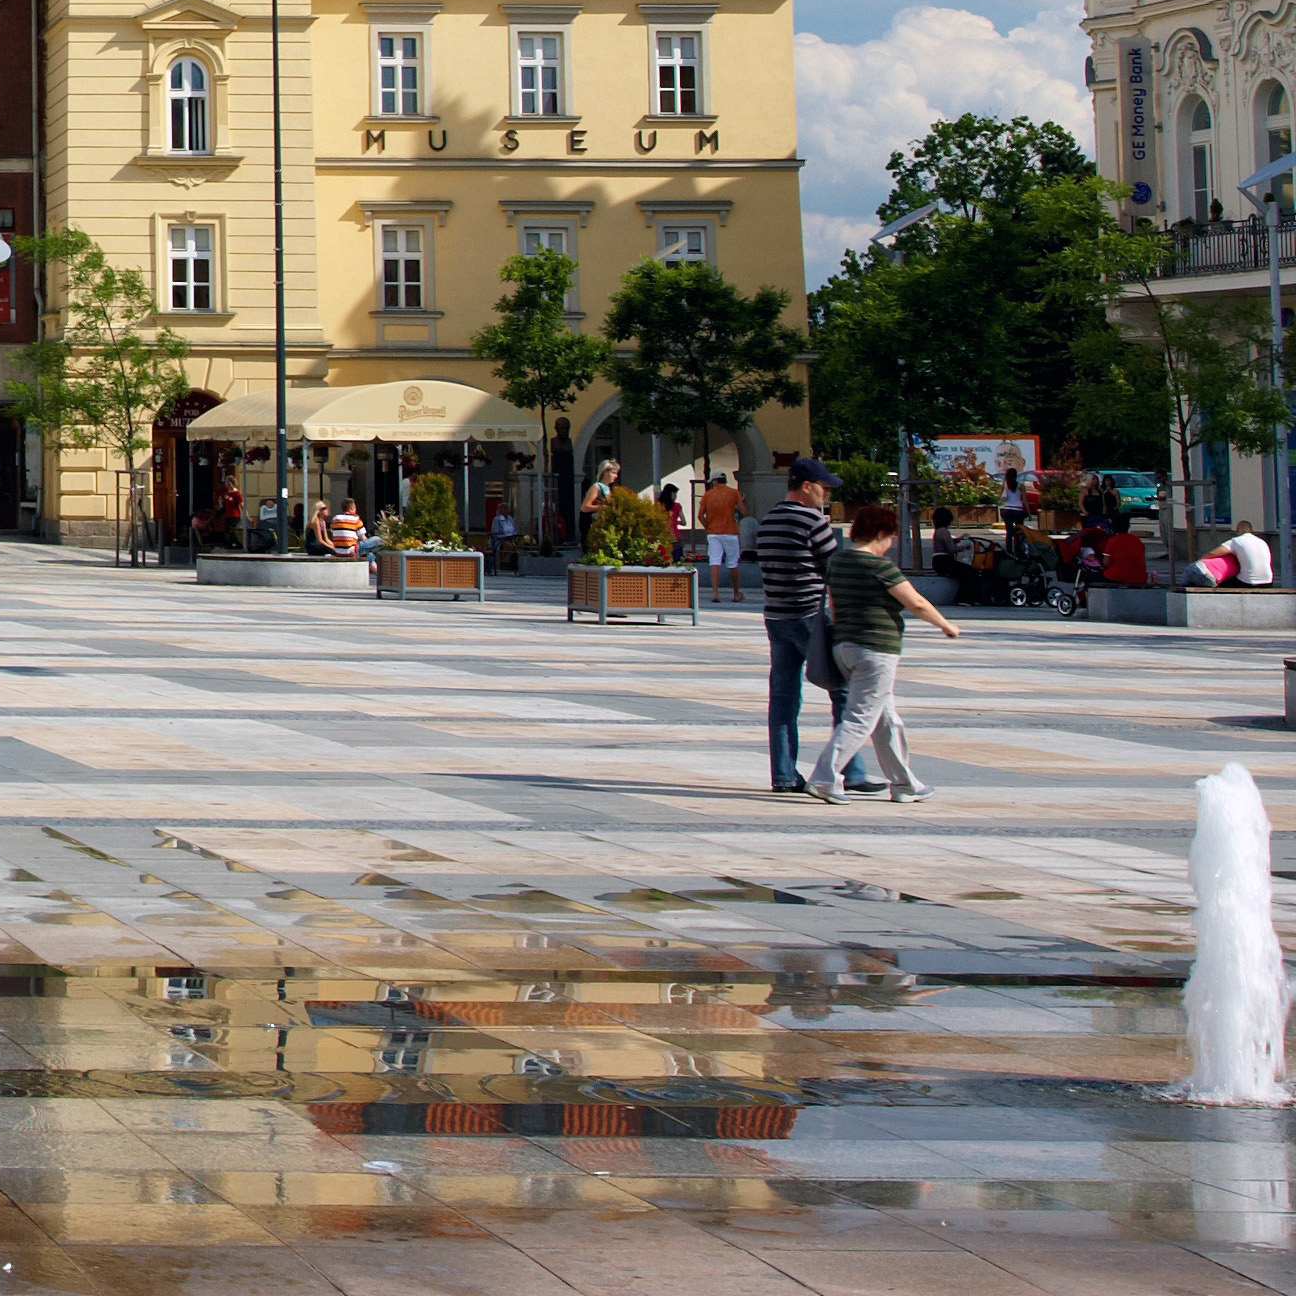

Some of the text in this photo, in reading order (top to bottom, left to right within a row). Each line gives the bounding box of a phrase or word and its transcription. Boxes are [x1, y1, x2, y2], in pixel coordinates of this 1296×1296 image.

[1129, 47, 1147, 161] GE Money Bank
[365, 128, 719, 151] MUSEUM
